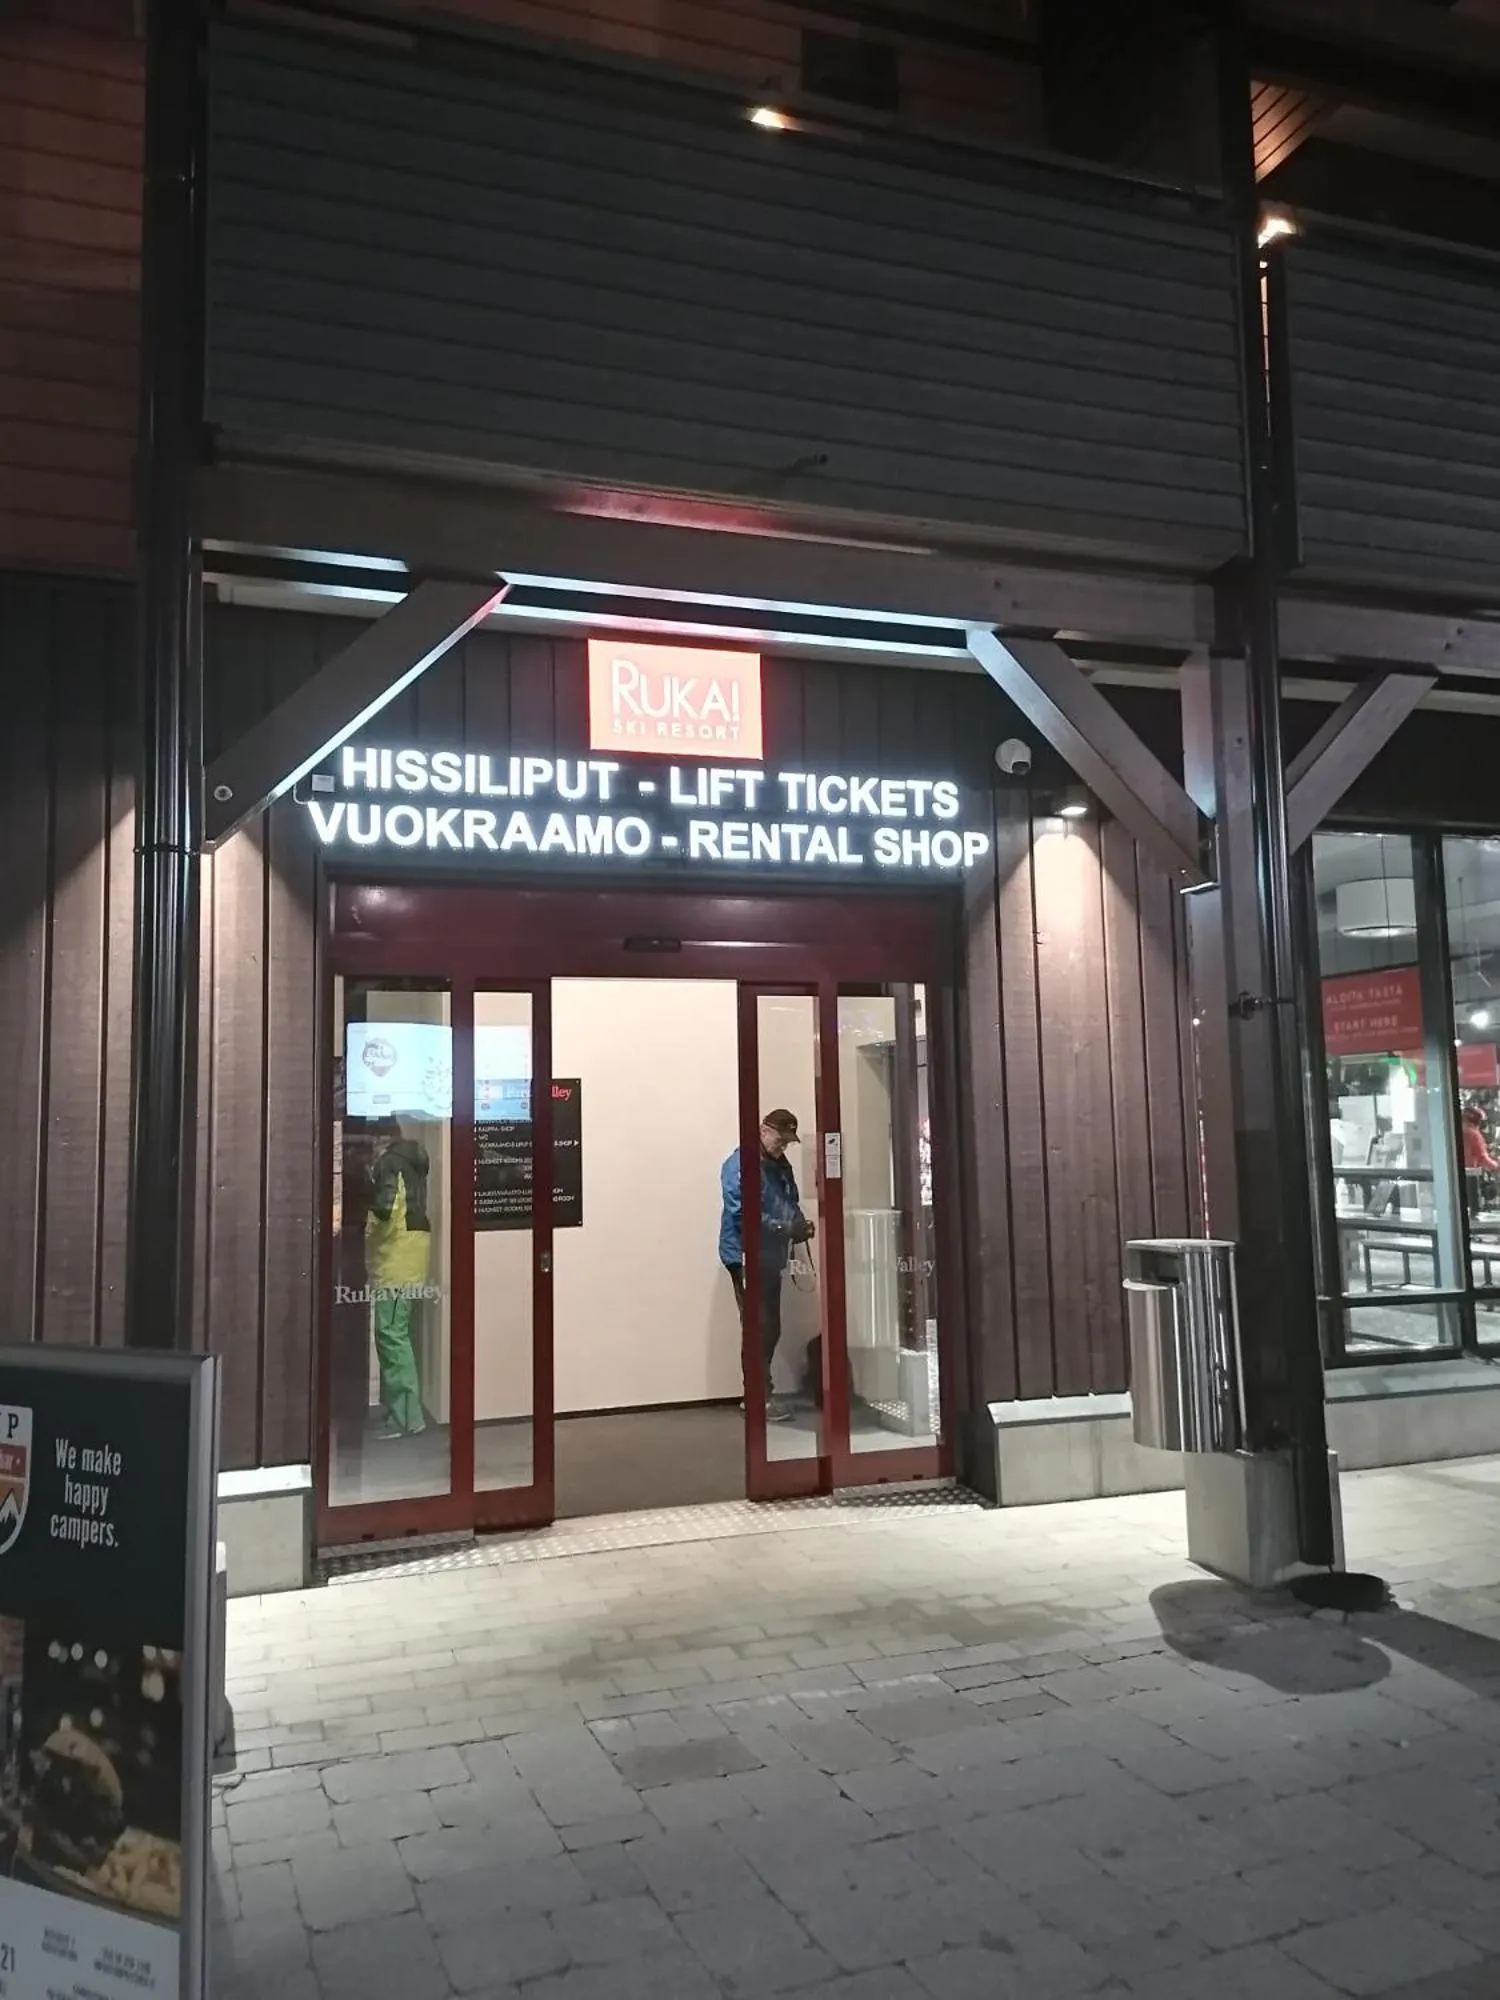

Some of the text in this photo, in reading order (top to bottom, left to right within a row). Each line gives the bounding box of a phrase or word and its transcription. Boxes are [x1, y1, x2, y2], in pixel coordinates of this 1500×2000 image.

[612, 718, 739, 741] SKI RESORT
[342, 746, 620, 801] HISSILIPUT
[670, 766, 764, 809] LIFT
[778, 772, 960, 818] TICKETS
[306, 800, 652, 857] VUOKRAAMO
[689, 819, 863, 864] RENTAL
[873, 827, 990, 867] SHOP
[552, 1084, 572, 1101] lley
[55, 1437, 122, 1476] We make
[64, 1473, 109, 1516] happy
[50, 1514, 119, 1549] campers.
